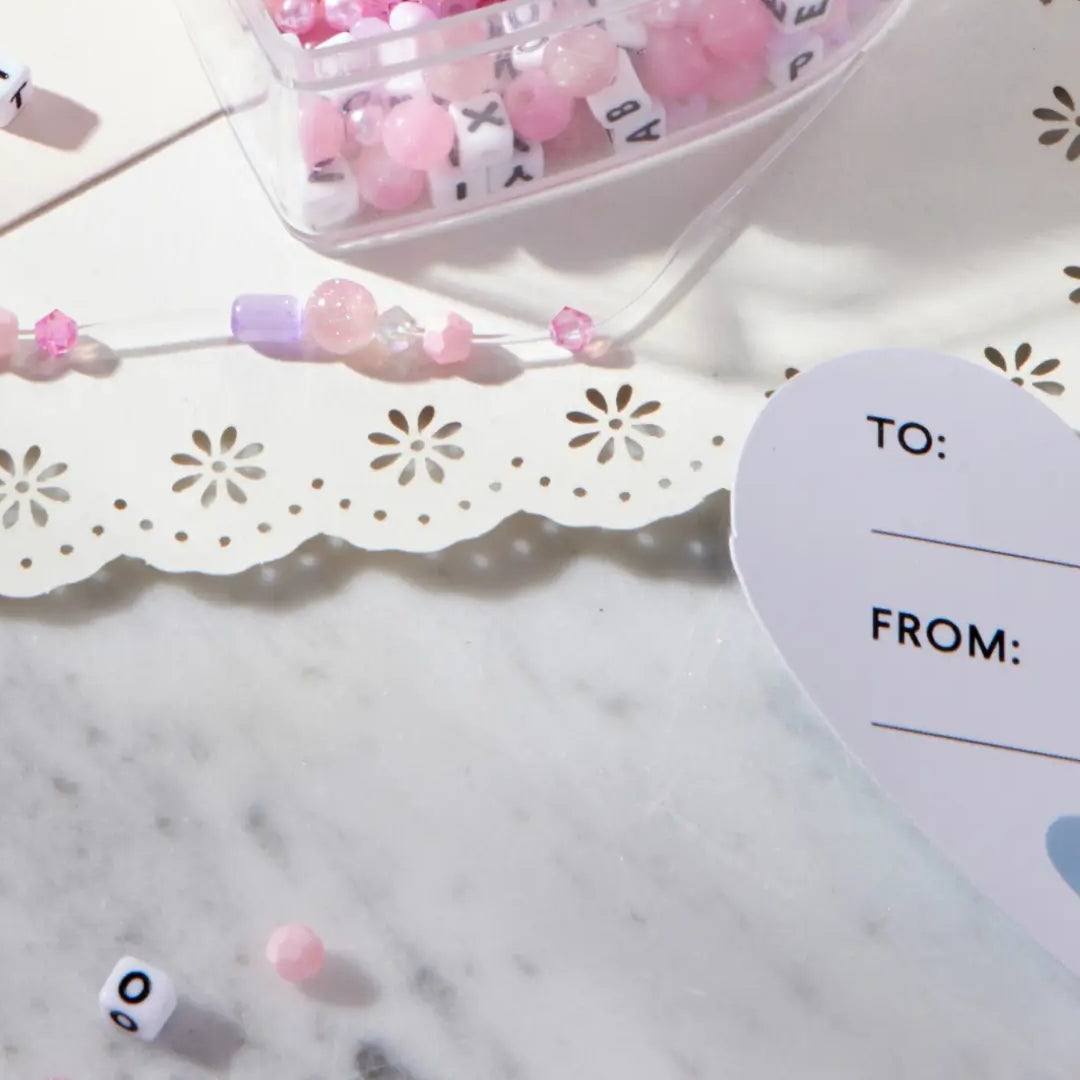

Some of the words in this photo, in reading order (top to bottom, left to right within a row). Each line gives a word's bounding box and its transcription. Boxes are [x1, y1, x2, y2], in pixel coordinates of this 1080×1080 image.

[461, 100, 506, 133] X
[866, 414, 947, 460] TO:
[870, 606, 1022, 665] FROM:
[118, 970, 152, 1005] O
